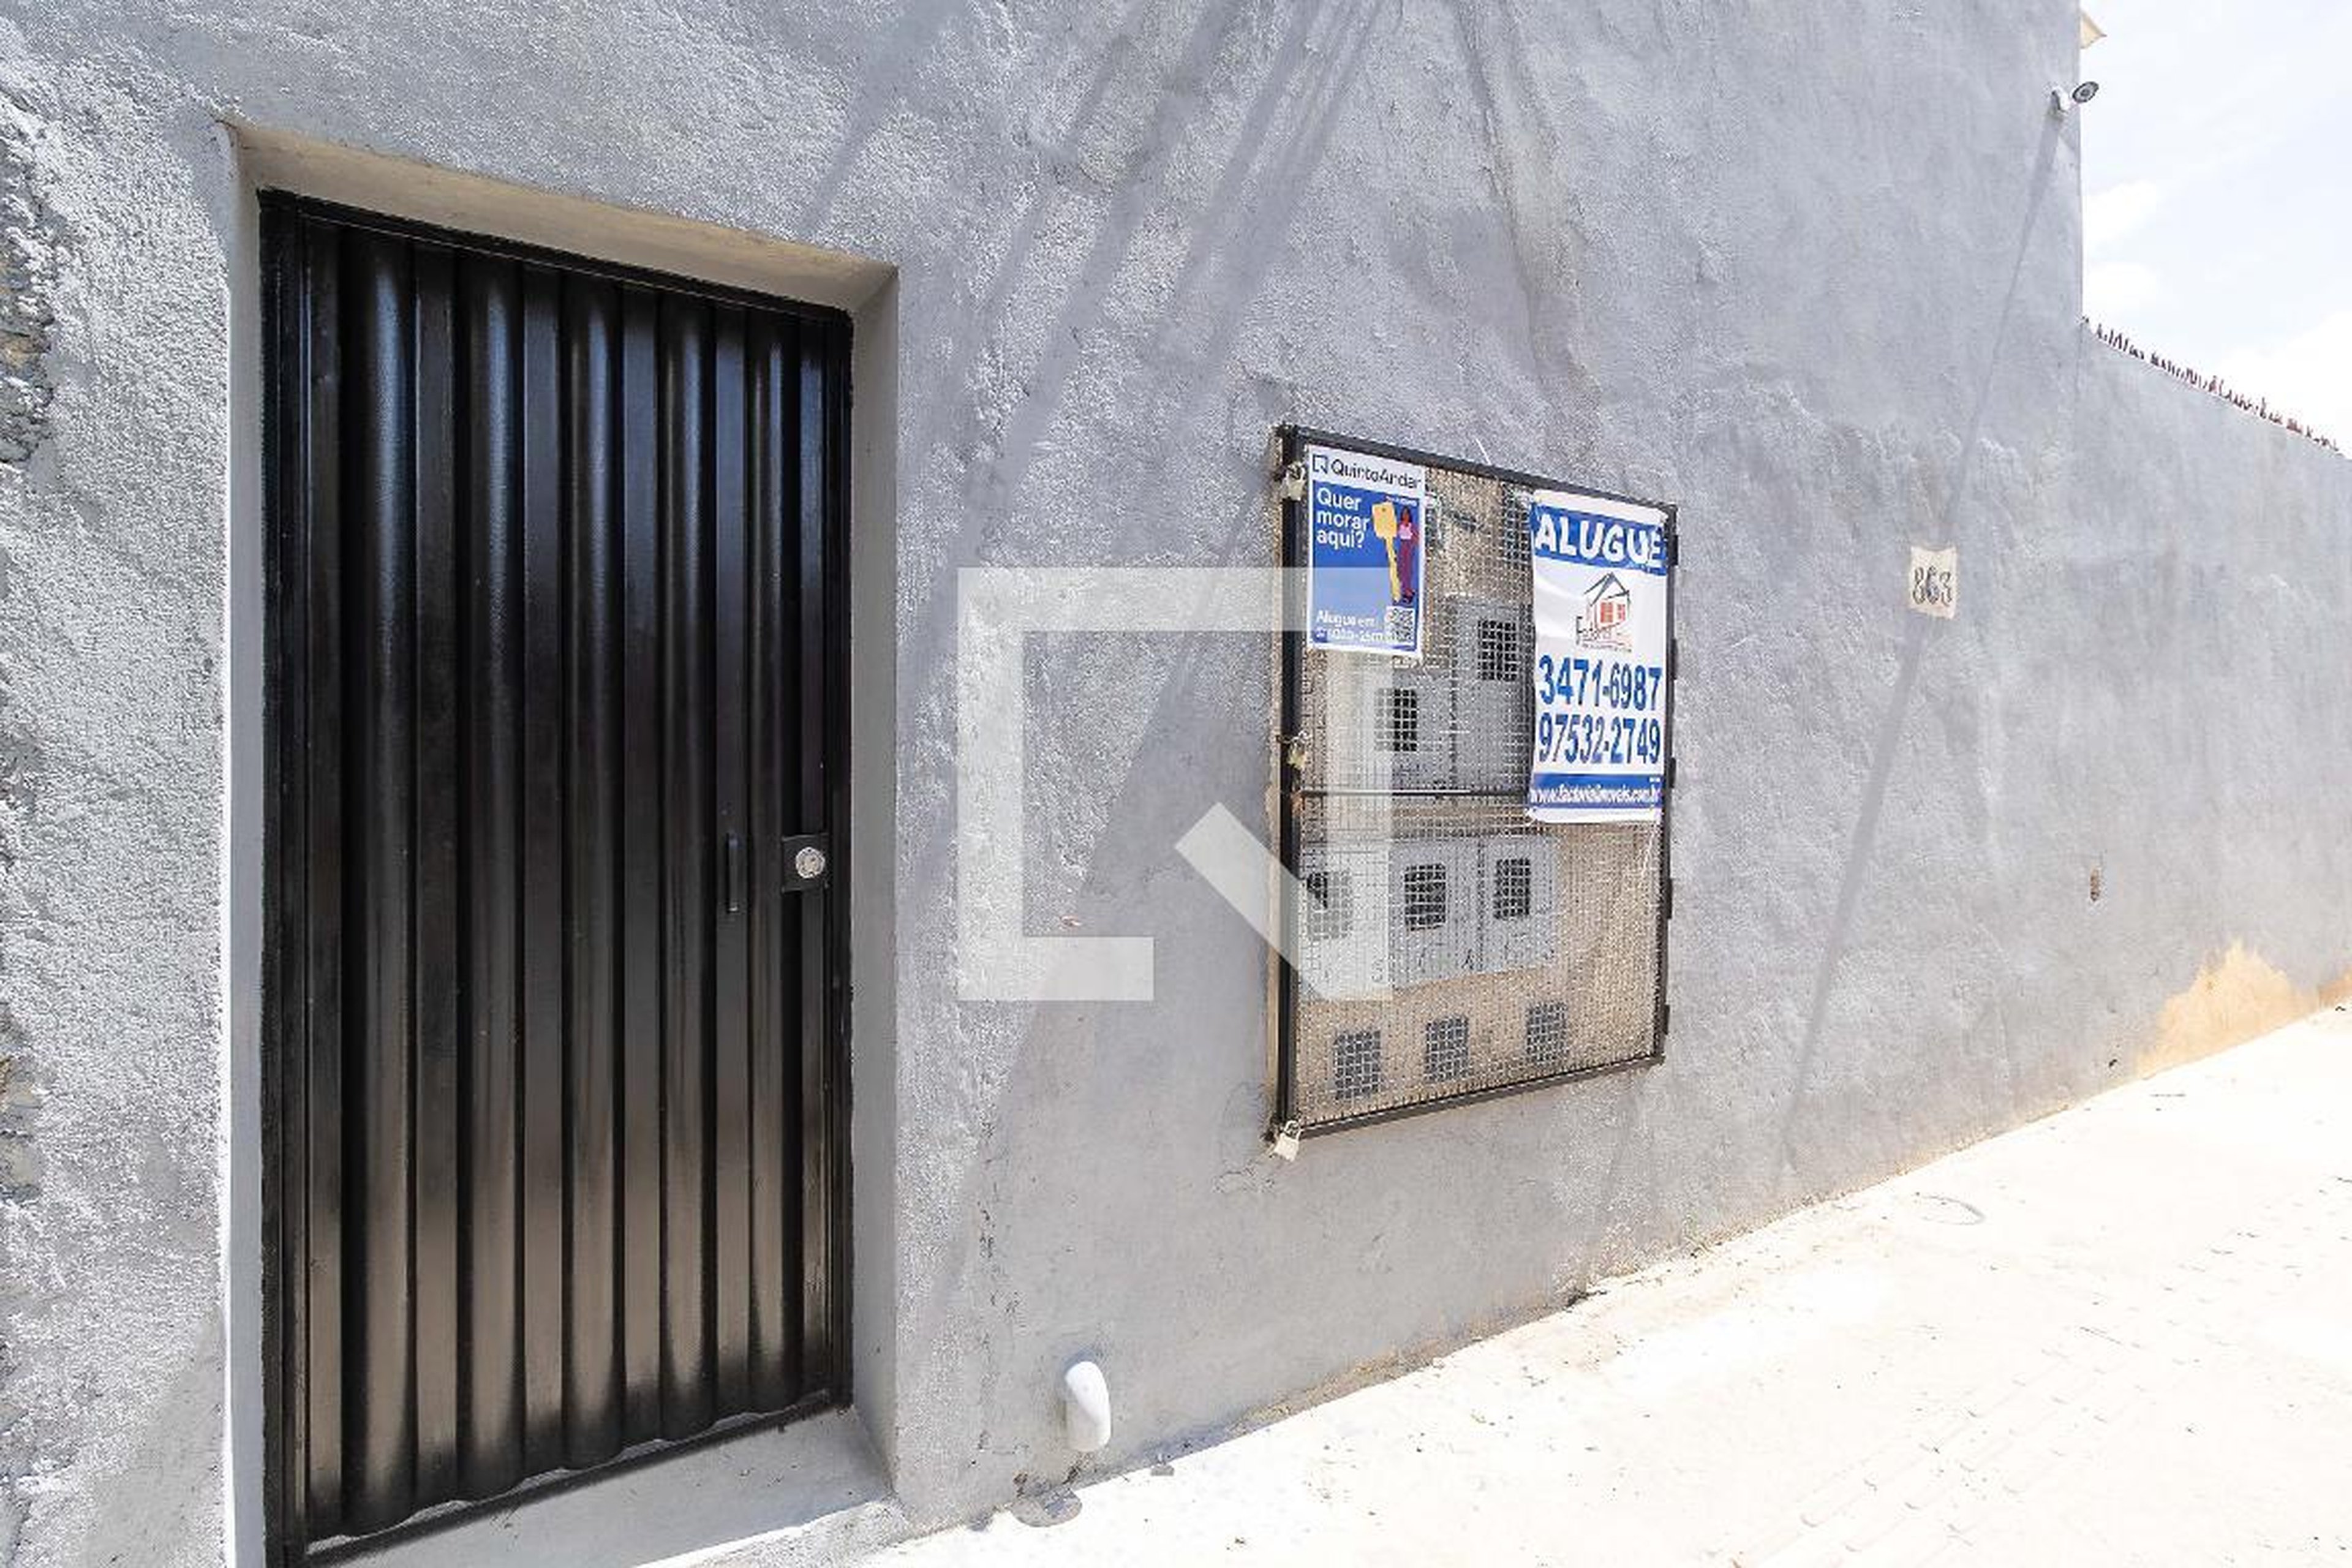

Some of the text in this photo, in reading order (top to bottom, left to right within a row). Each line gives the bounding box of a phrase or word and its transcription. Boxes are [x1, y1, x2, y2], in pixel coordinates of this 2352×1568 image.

[1331, 459, 1422, 489] QuintoAndar
[1317, 488, 1362, 511] Quer
[1317, 510, 1371, 532] morar
[1316, 529, 1365, 550] aqui?
[1534, 513, 1664, 568] ALUGUE
[1912, 565, 1953, 607] 863
[1539, 654, 1662, 711] 3471-6987
[1539, 712, 1660, 764] 97532-2749
